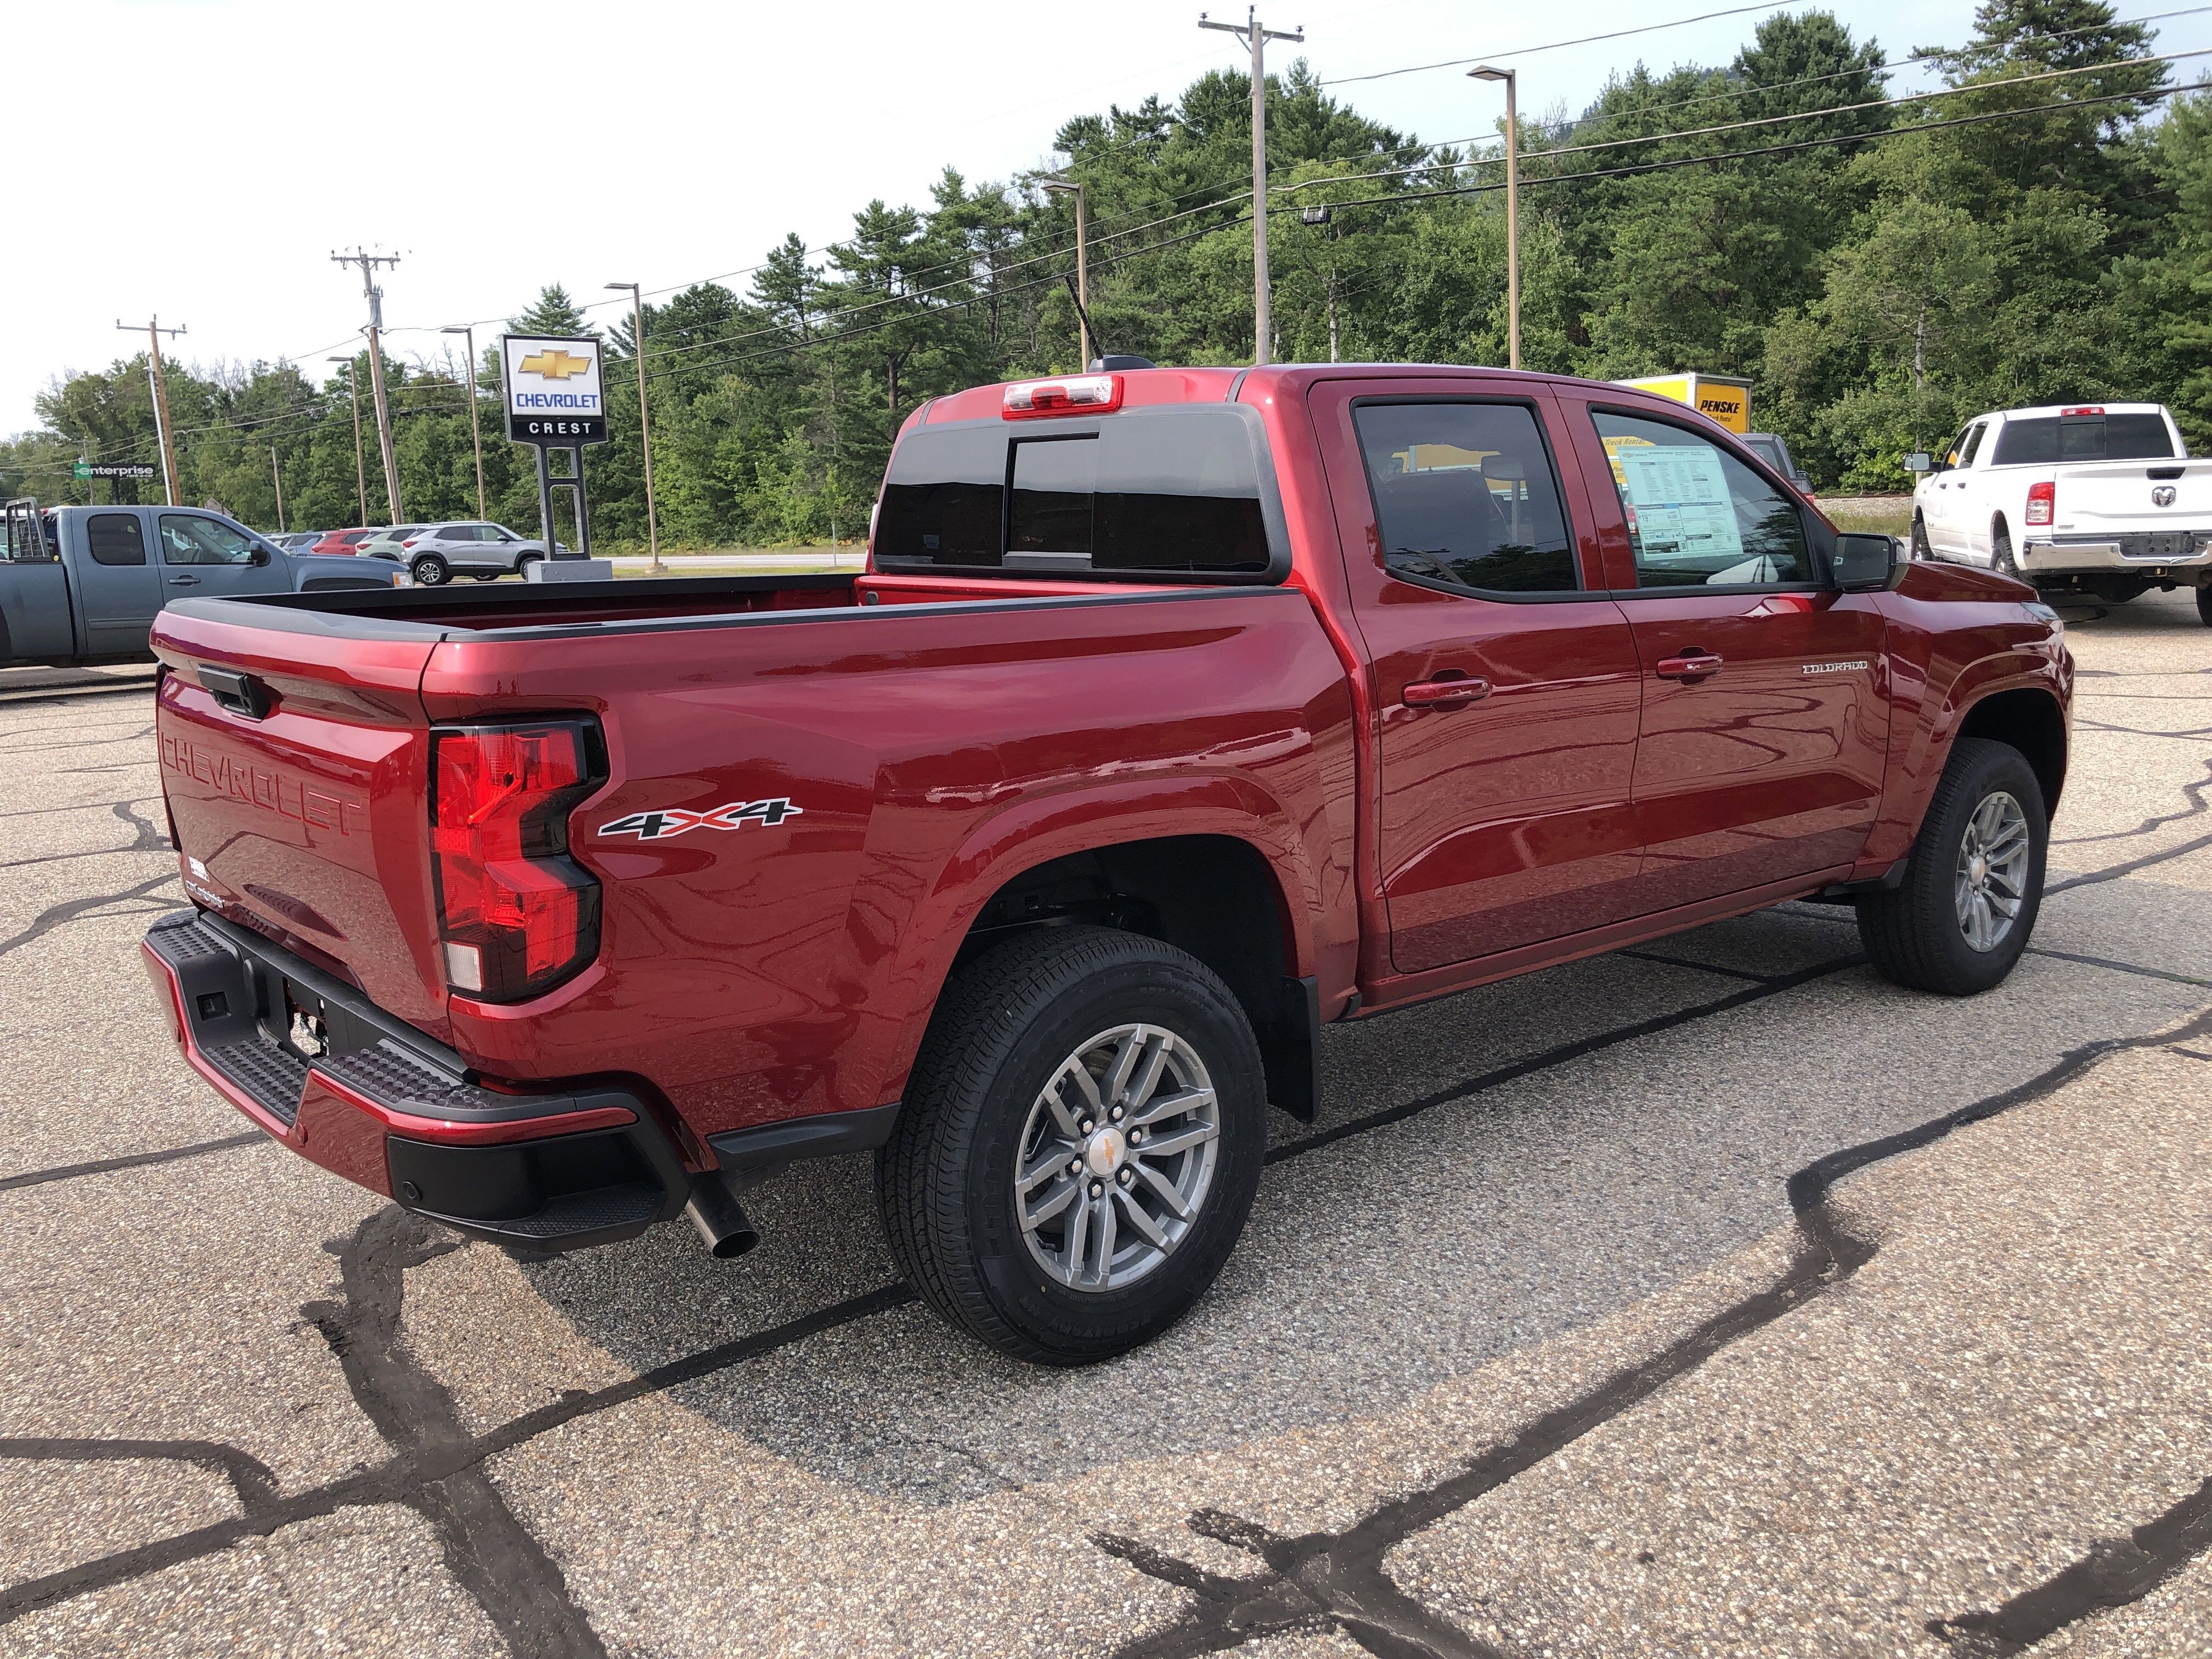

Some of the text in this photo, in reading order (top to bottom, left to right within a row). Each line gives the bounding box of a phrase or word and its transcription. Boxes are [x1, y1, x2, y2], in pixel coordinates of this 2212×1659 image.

[516, 393, 598, 408] CHEVROLET
[1700, 400, 1740, 414] PENSKE
[529, 422, 591, 434] CREST
[79, 465, 154, 477] enterprise
[1803, 661, 1868, 674] COLORADO
[161, 732, 360, 837] CHEVROLET
